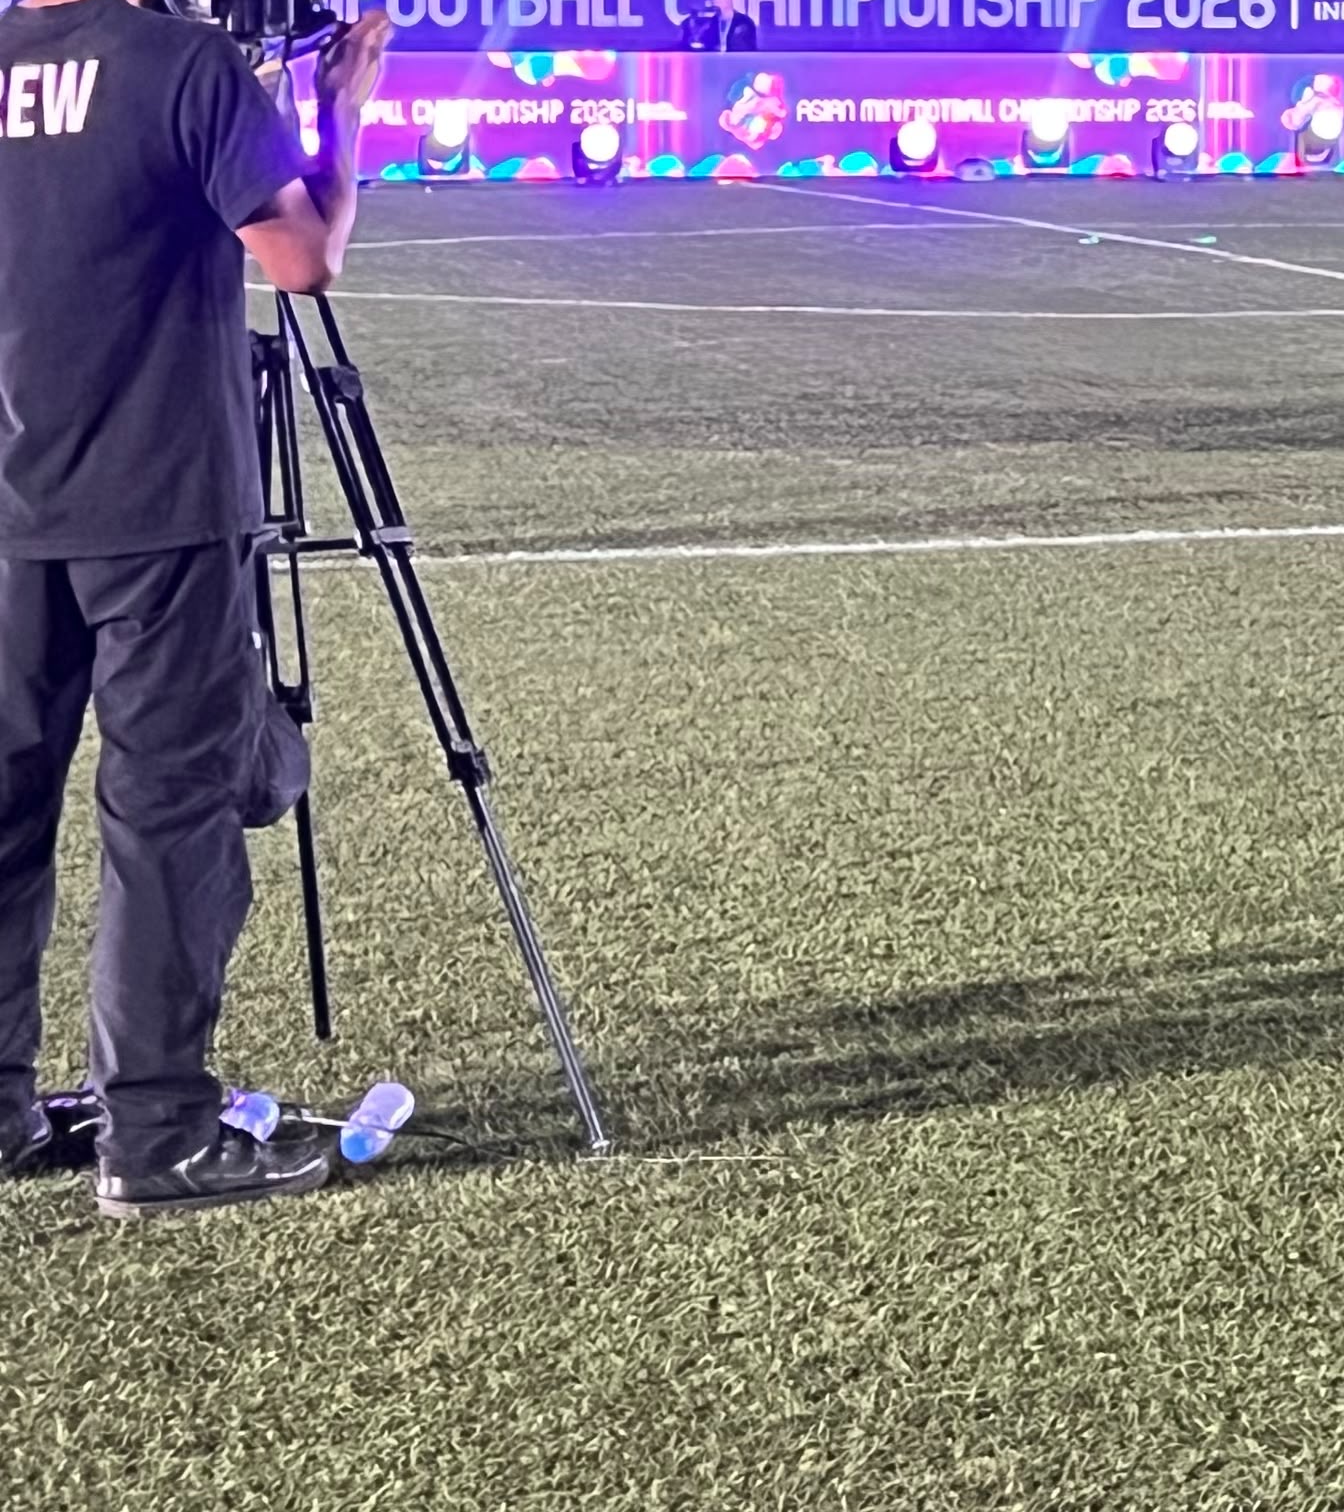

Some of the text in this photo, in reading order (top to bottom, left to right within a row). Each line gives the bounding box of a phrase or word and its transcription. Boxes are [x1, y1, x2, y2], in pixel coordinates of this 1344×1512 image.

[0, 59, 99, 138] EW
[796, 99, 856, 122] ASIAN
[1146, 99, 1197, 123] 2026
[412, 99, 564, 124] CHPIONSHIP
[570, 99, 625, 124] 2026
